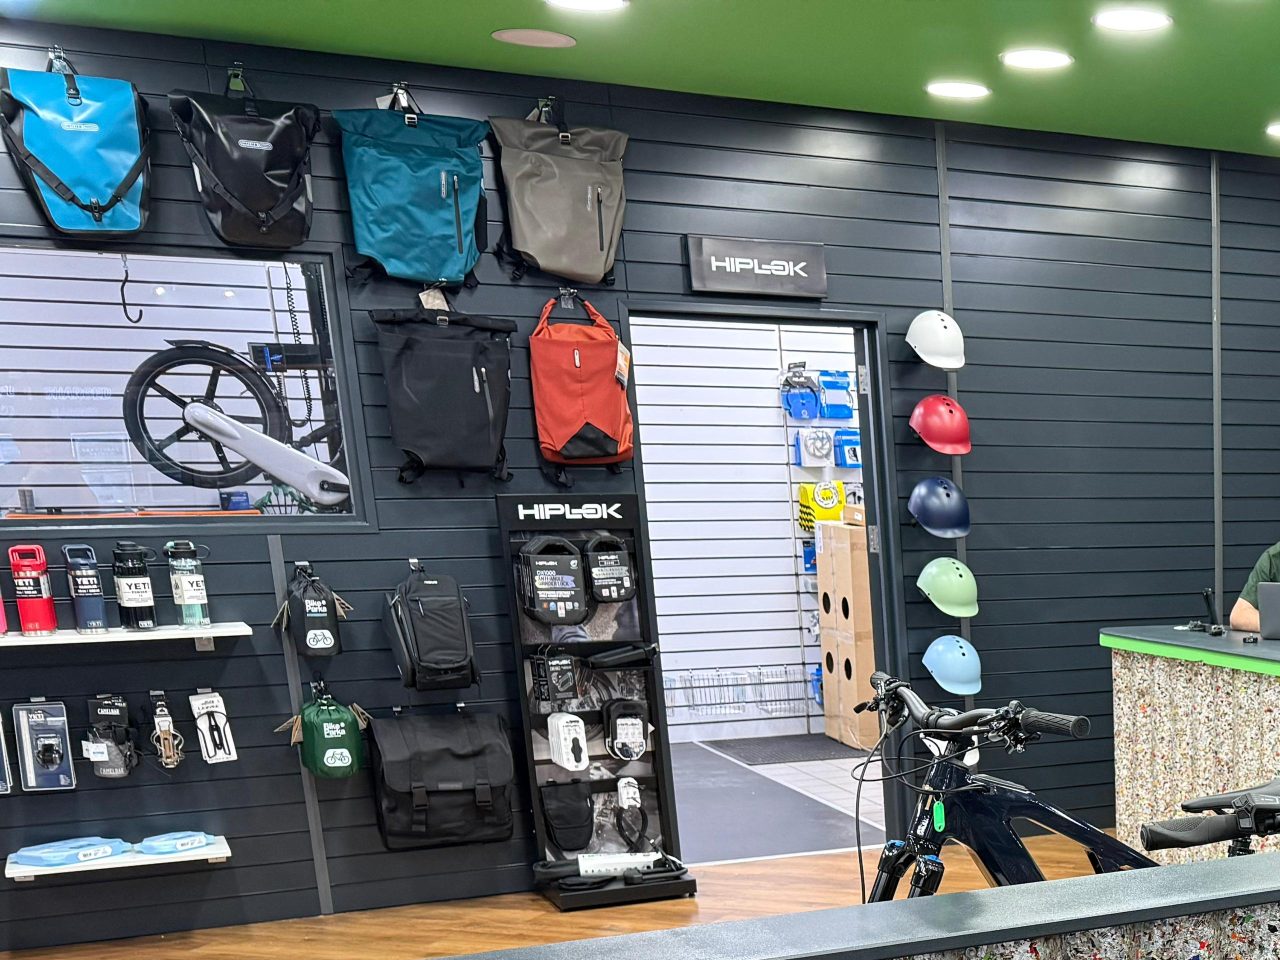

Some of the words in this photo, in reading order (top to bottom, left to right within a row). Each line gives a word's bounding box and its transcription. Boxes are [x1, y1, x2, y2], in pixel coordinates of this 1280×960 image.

[710, 255, 808, 277] HIPLOK
[517, 503, 622, 519] HIPLOK
[75, 577, 98, 585] YETI
[126, 582, 150, 590] YETI
